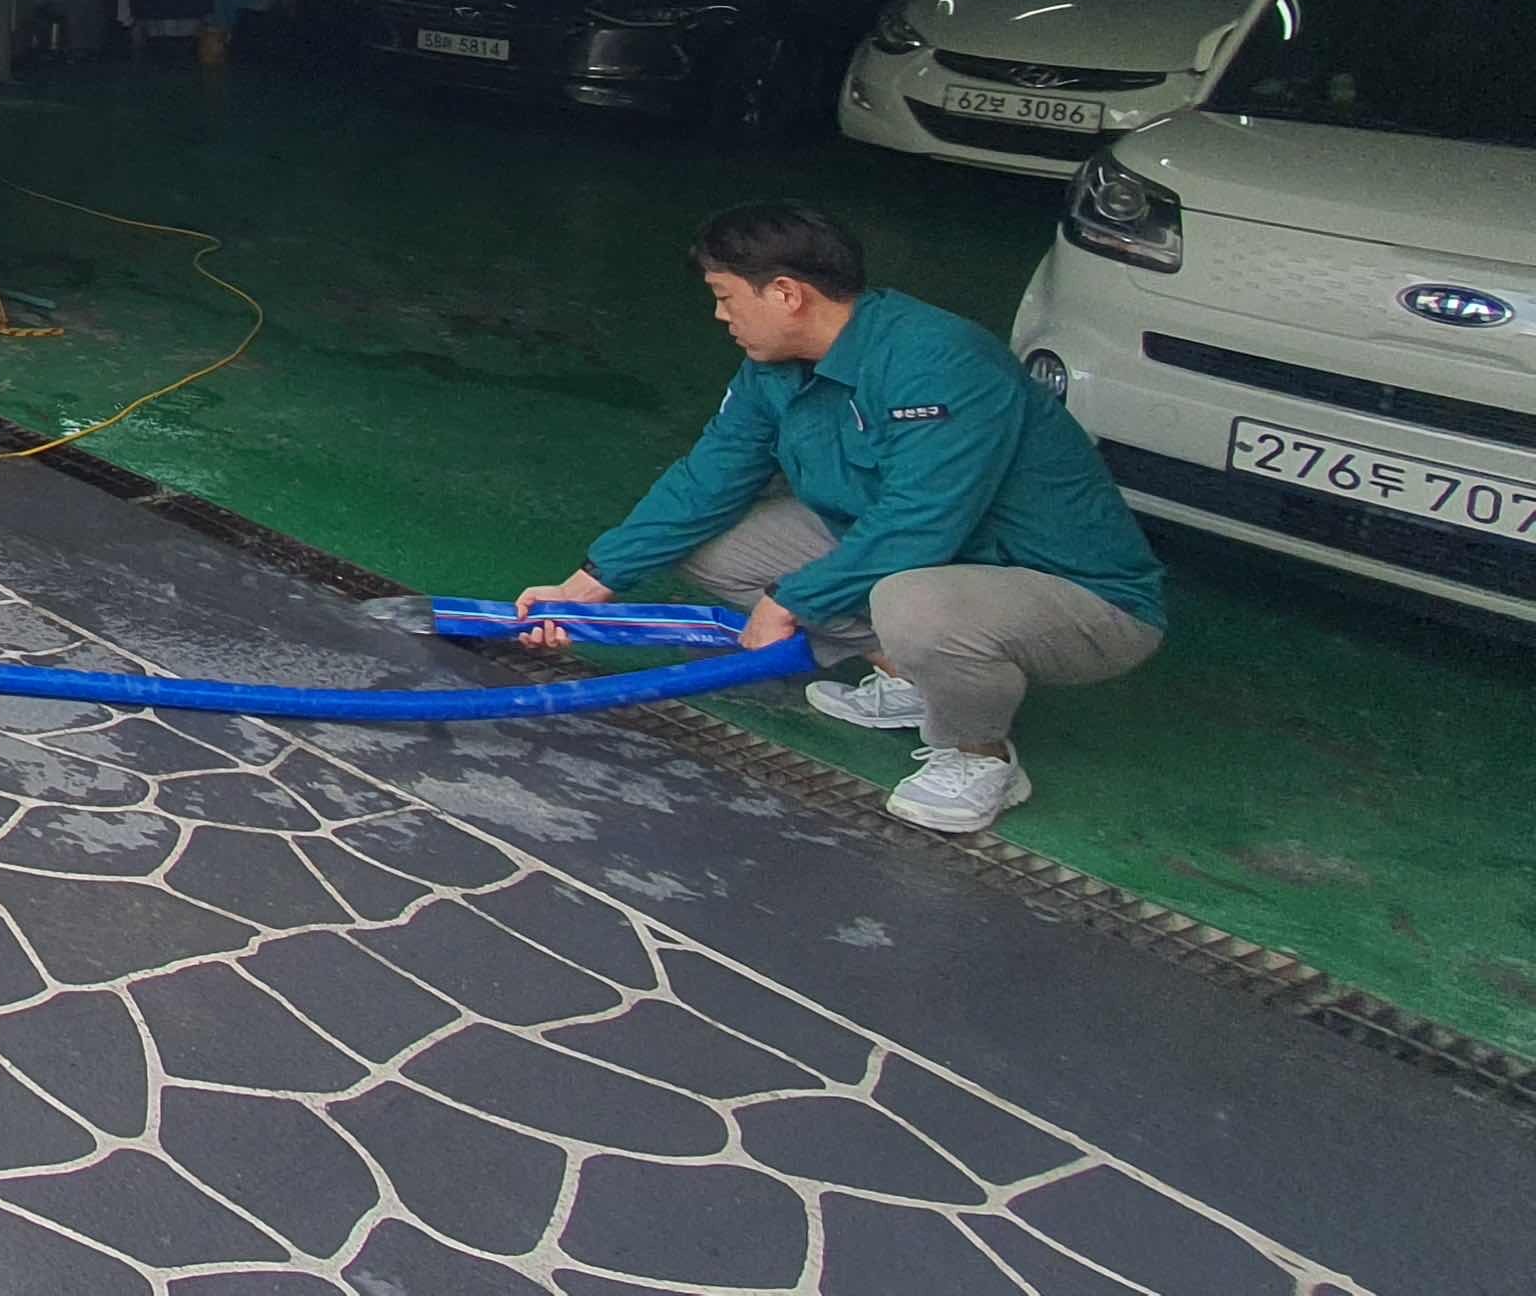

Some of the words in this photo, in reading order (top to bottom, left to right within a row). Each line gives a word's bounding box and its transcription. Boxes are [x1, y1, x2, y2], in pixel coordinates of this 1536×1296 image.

[958, 91, 1006, 113] 62보
[1017, 98, 1085, 124] 3086
[1415, 290, 1497, 322] KIA
[1254, 433, 1408, 498] 276두
